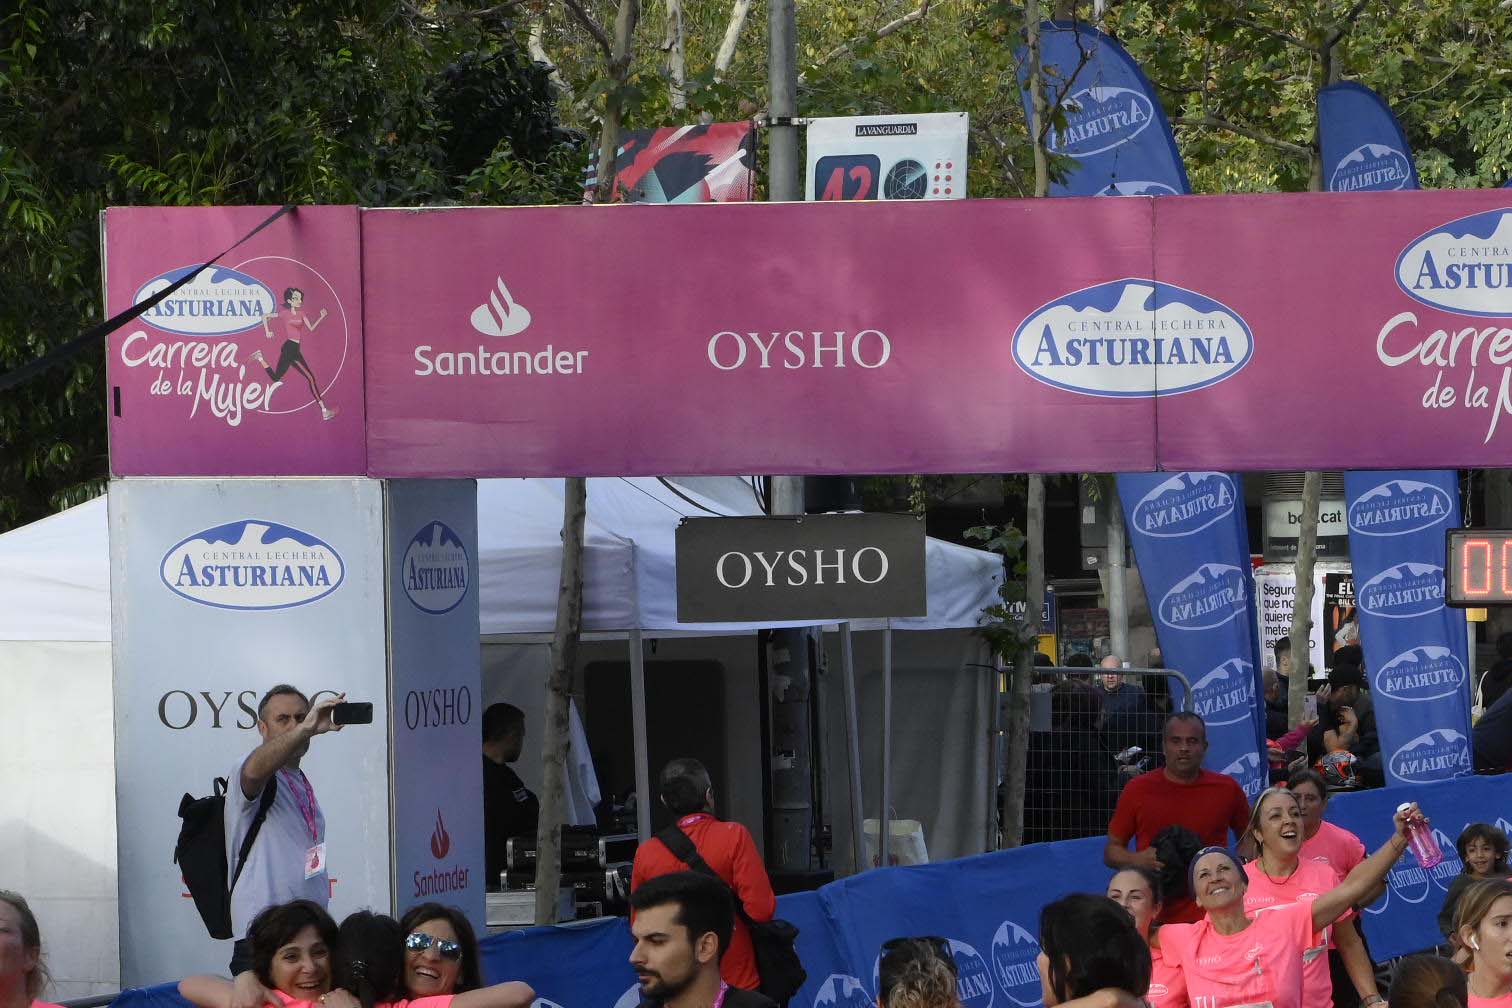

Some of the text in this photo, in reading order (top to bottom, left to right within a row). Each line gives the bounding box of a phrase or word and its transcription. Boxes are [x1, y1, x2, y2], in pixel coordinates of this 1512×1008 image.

[1068, 318, 1226, 332] CENTRAL LECHERA
[121, 331, 239, 369] Carrera
[414, 344, 590, 377] Santander
[707, 329, 891, 371] OYSHO
[1031, 323, 1235, 368] ASTURIANA
[151, 365, 283, 427] de la Mujer
[1422, 375, 1456, 409] de
[1464, 369, 1489, 408] la
[175, 554, 331, 588] ASTURIANA
[203, 551, 325, 561] CENTRAL LECHERA
[407, 556, 466, 591] ASTURIANA
[715, 546, 889, 588] OYSHO
[1263, 600, 1281, 610] que
[1264, 612, 1294, 625] quiere
[157, 689, 342, 730] OYS
[405, 685, 472, 731] OYSHO
[413, 864, 470, 898] Santander
